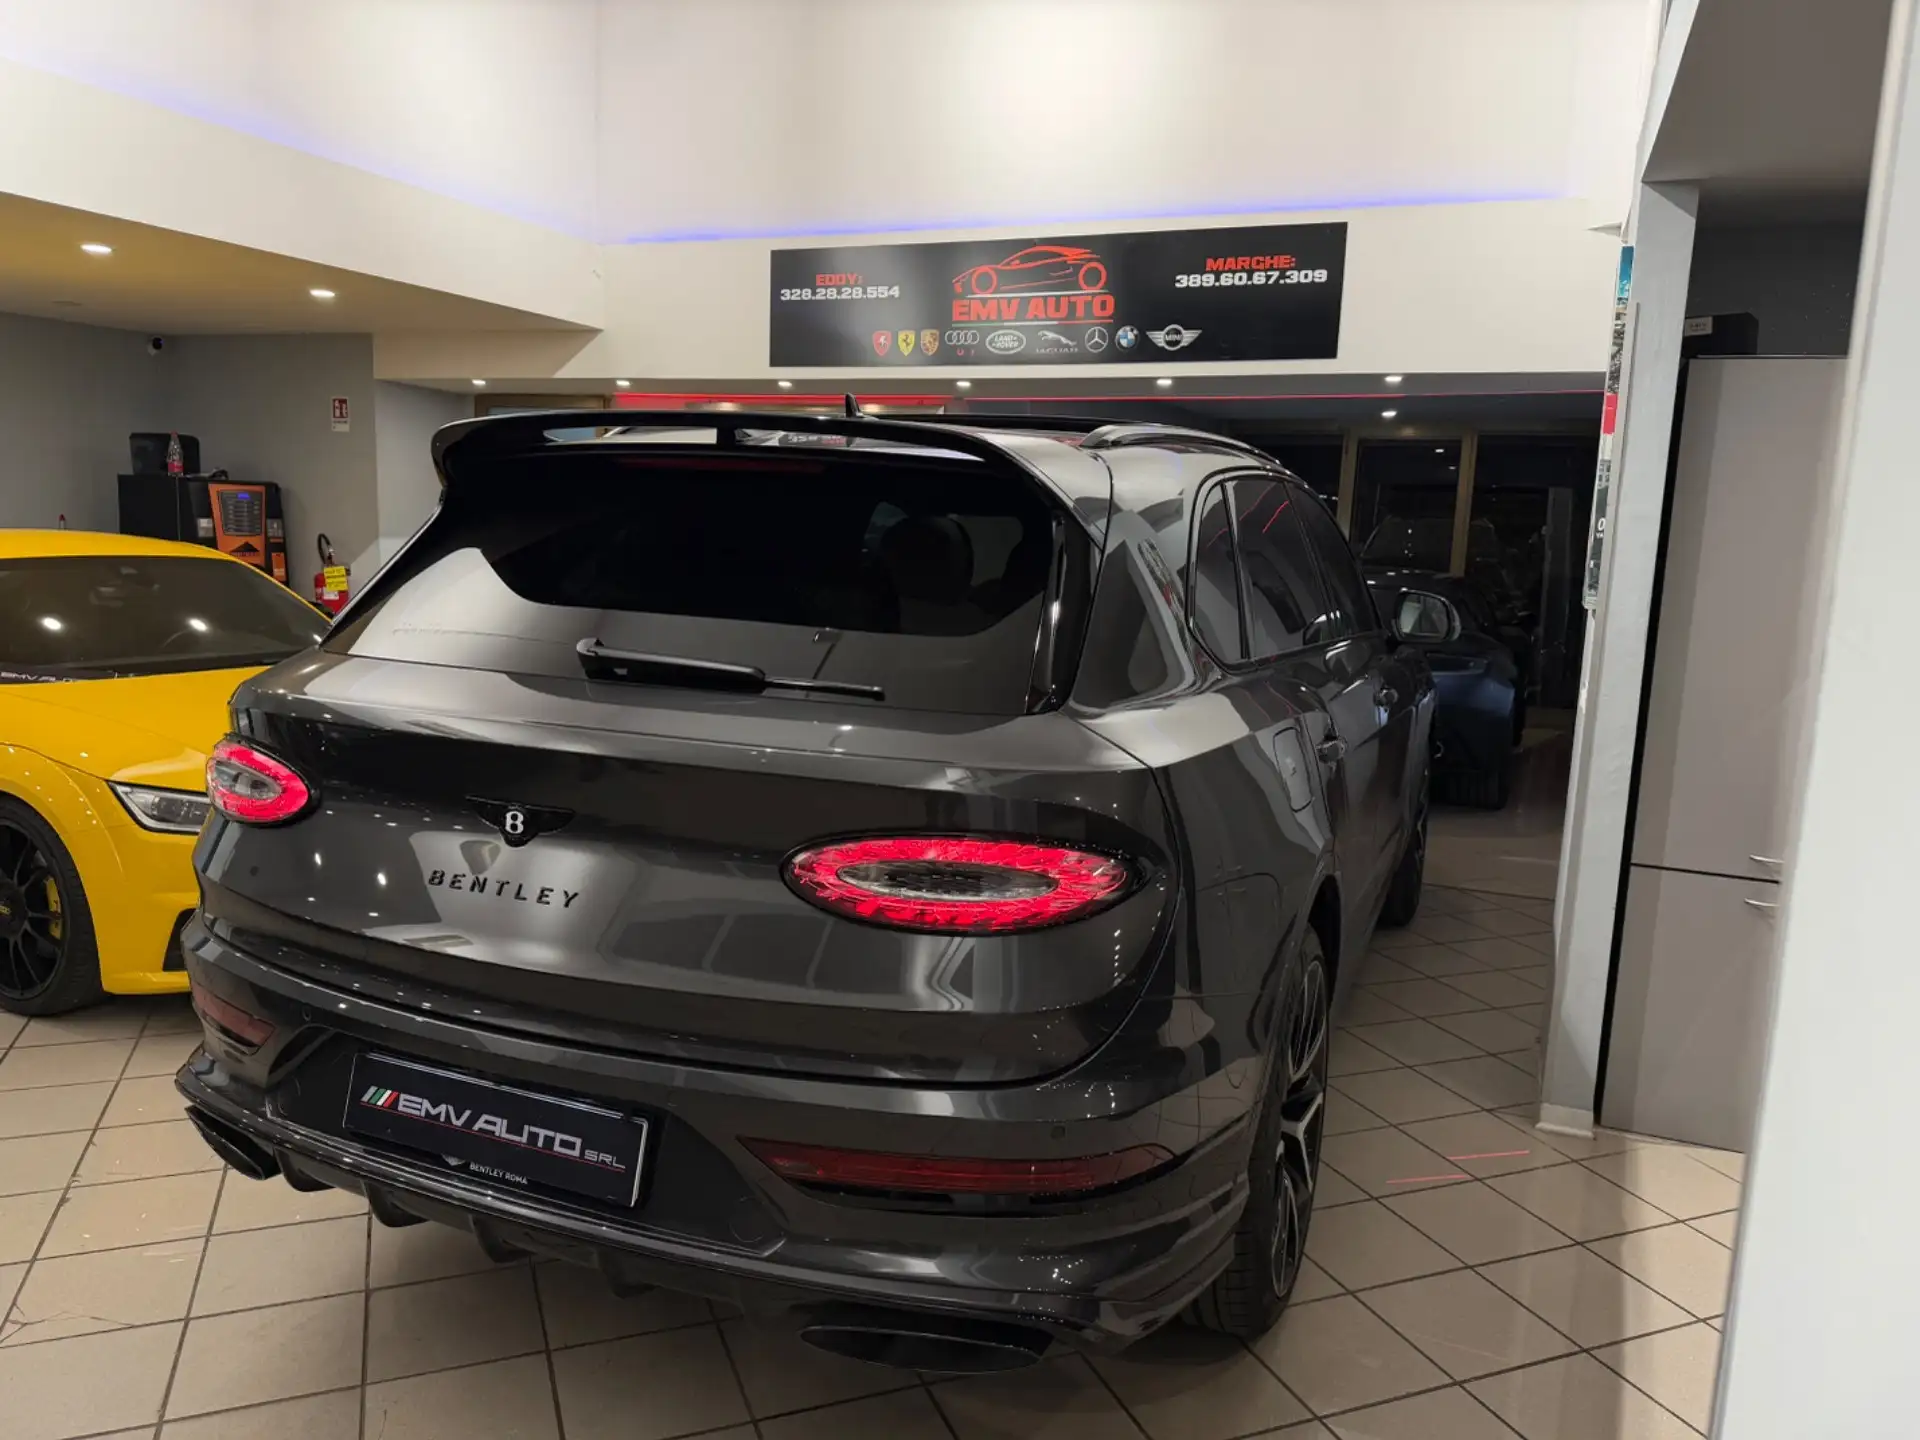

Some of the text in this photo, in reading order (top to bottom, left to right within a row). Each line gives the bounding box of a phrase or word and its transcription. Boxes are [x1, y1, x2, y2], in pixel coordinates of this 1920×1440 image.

[1206, 255, 1296, 271] MARCHE:
[1175, 269, 1328, 288] 389.60.67.309
[780, 285, 900, 301] 328.28.28.554
[952, 294, 1115, 321] EMV AUTO
[428, 868, 580, 909] BENTLEY
[398, 1092, 626, 1170] EMV AUTO SRL
[469, 1161, 528, 1185] BENTLEY ROMA
